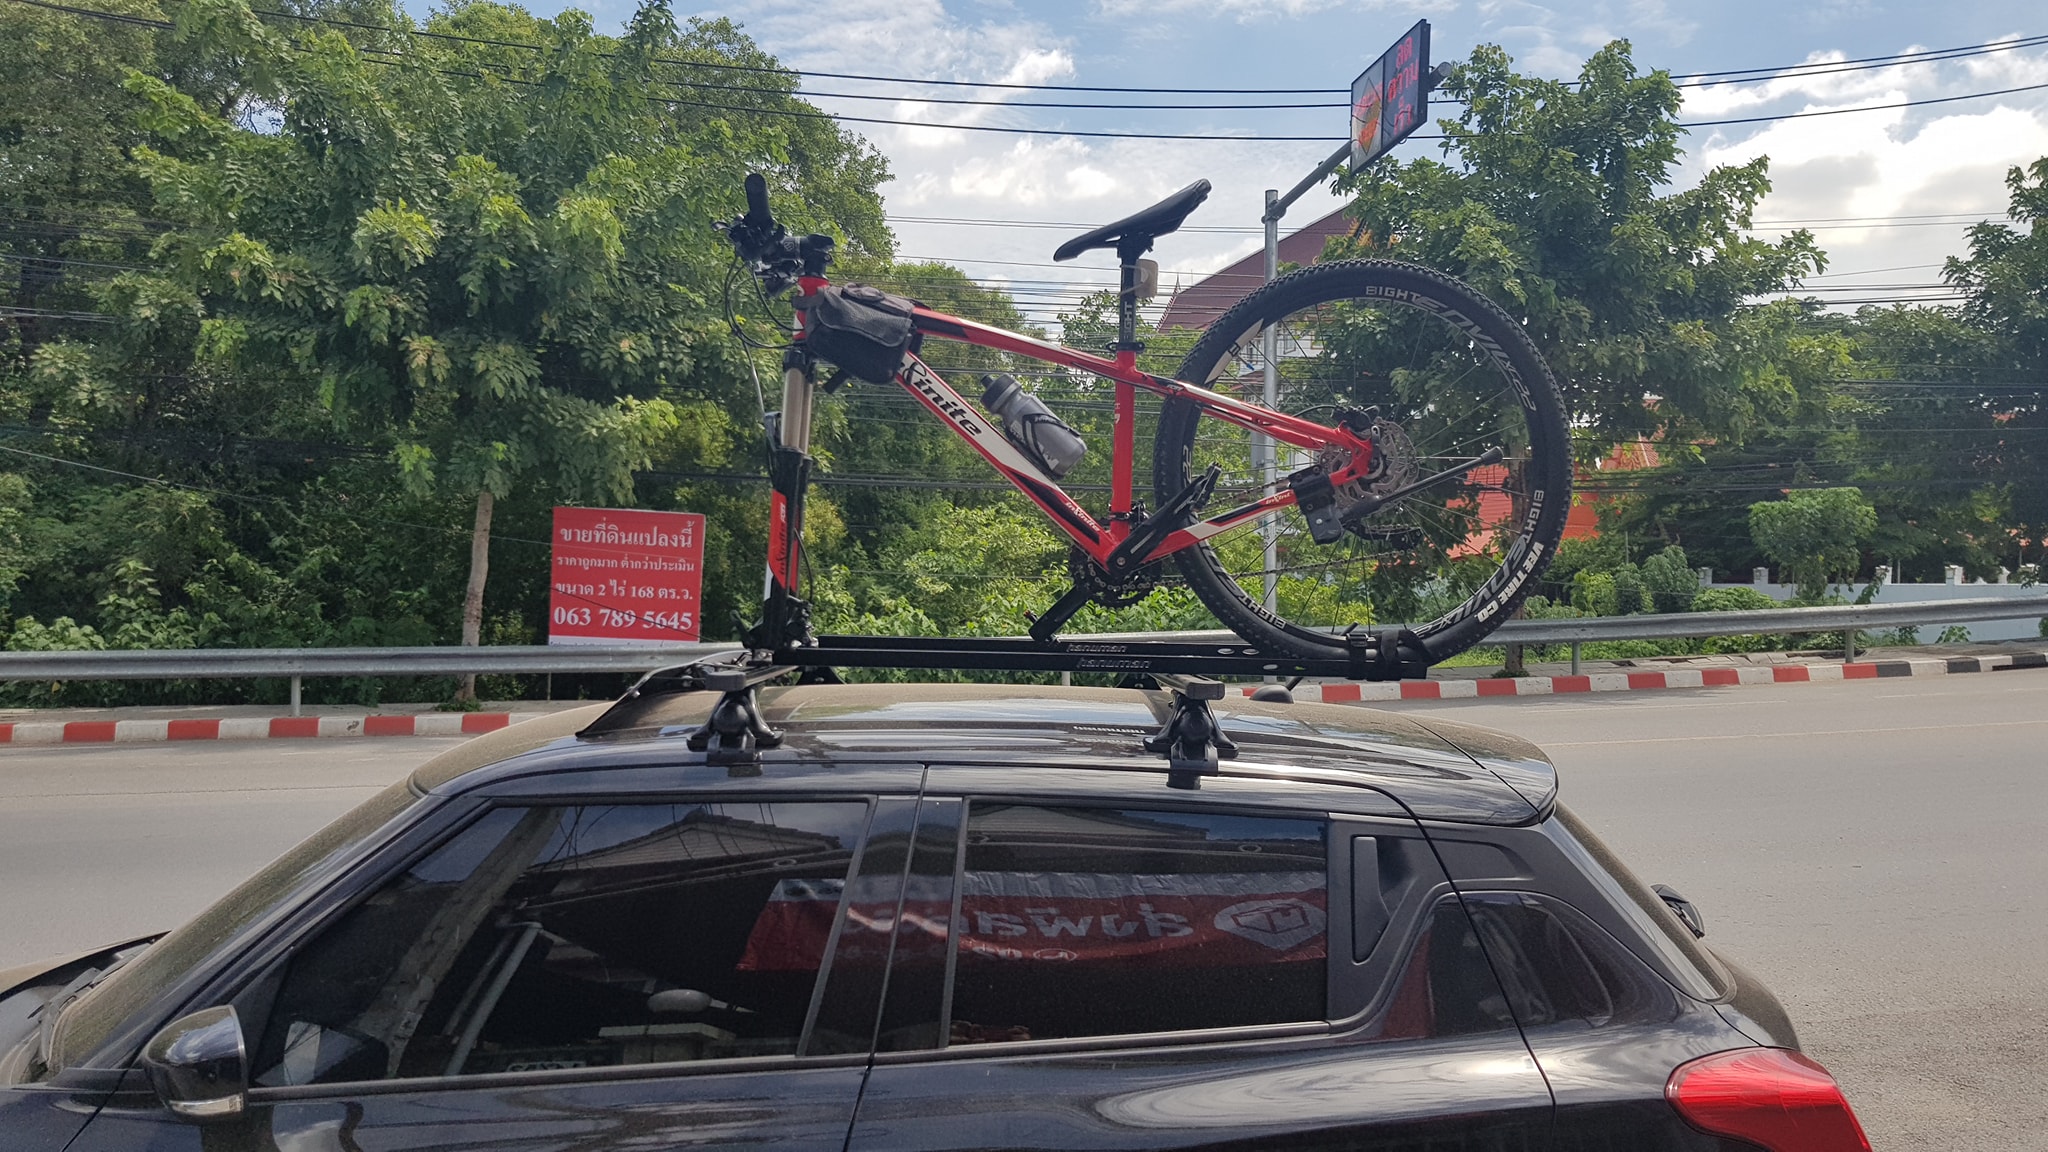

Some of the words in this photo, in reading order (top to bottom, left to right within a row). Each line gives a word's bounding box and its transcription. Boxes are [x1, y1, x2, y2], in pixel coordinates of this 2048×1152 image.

[1365, 285, 1421, 302] BIGHT
[1523, 489, 1544, 543] BIGHT
[560, 516, 695, 548] ขายที่ดินแปลงนี้
[556, 555, 618, 571] ราคาถูกมาก
[621, 553, 695, 572] ต่ำกว่าประเมิน
[1523, 541, 1545, 573] VEE
[555, 582, 594, 596] ขนาด
[598, 584, 606, 596] 2
[609, 578, 627, 597] ไร่
[631, 585, 654, 599] 168
[1497, 570, 1528, 605] TIRE
[553, 606, 592, 626] 063
[598, 608, 637, 628] 789
[642, 610, 693, 630] 5645
[1474, 600, 1499, 624] CO.
